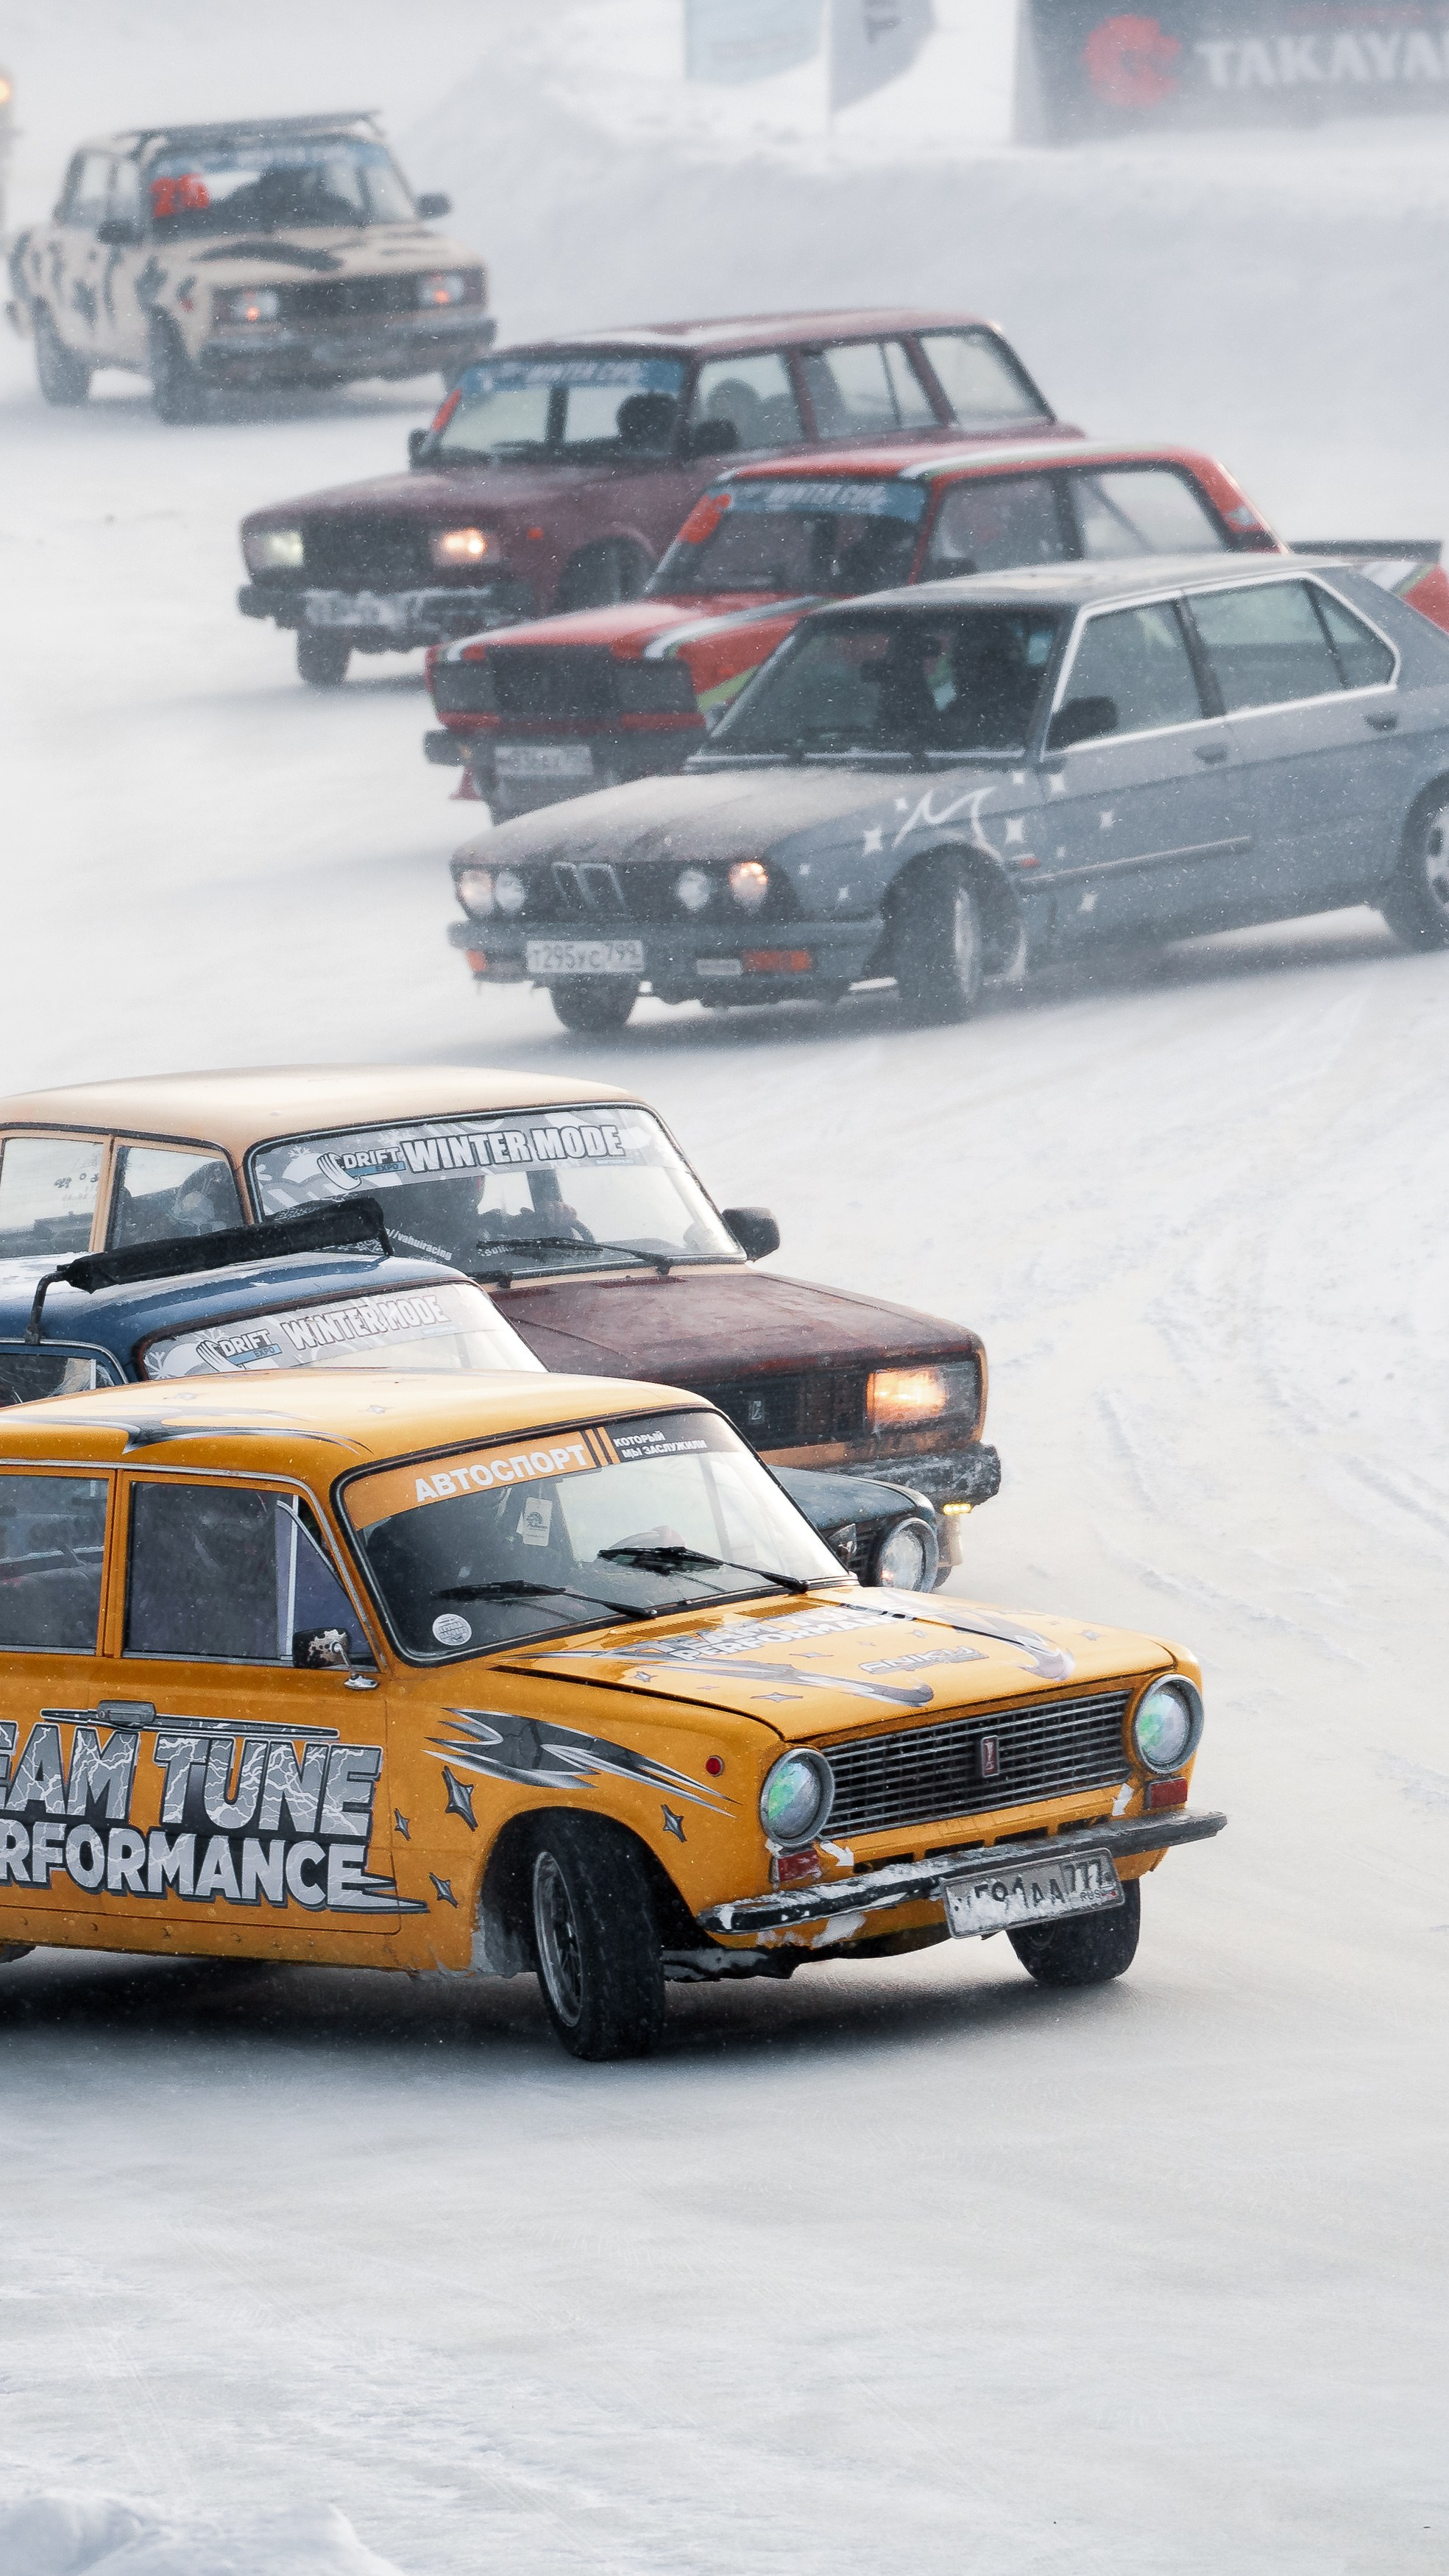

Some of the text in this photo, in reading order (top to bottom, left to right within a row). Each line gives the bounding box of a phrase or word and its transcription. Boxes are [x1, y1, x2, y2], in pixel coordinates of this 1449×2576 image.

[1192, 28, 1449, 87] TAKAYA
[342, 1146, 401, 1169] DRIFT
[400, 1125, 626, 1173] WINTER MODE
[374, 1163, 400, 1172] EXPO
[279, 1295, 453, 1351] WINTER MODE
[219, 1328, 275, 1356] DRIFT
[252, 1345, 276, 1359] EXPO
[612, 1430, 666, 1448] КОТОРЫЙ
[621, 1439, 708, 1458] МЫ ЗАСЛУЖИЛИ
[414, 1443, 589, 1502] АВТОСПОРТ
[671, 1608, 896, 1662] PERFORMAN
[0, 1719, 383, 1838] AM TUNE
[1064, 1857, 1102, 1894] 777
[1080, 1889, 1102, 1901] RUS
